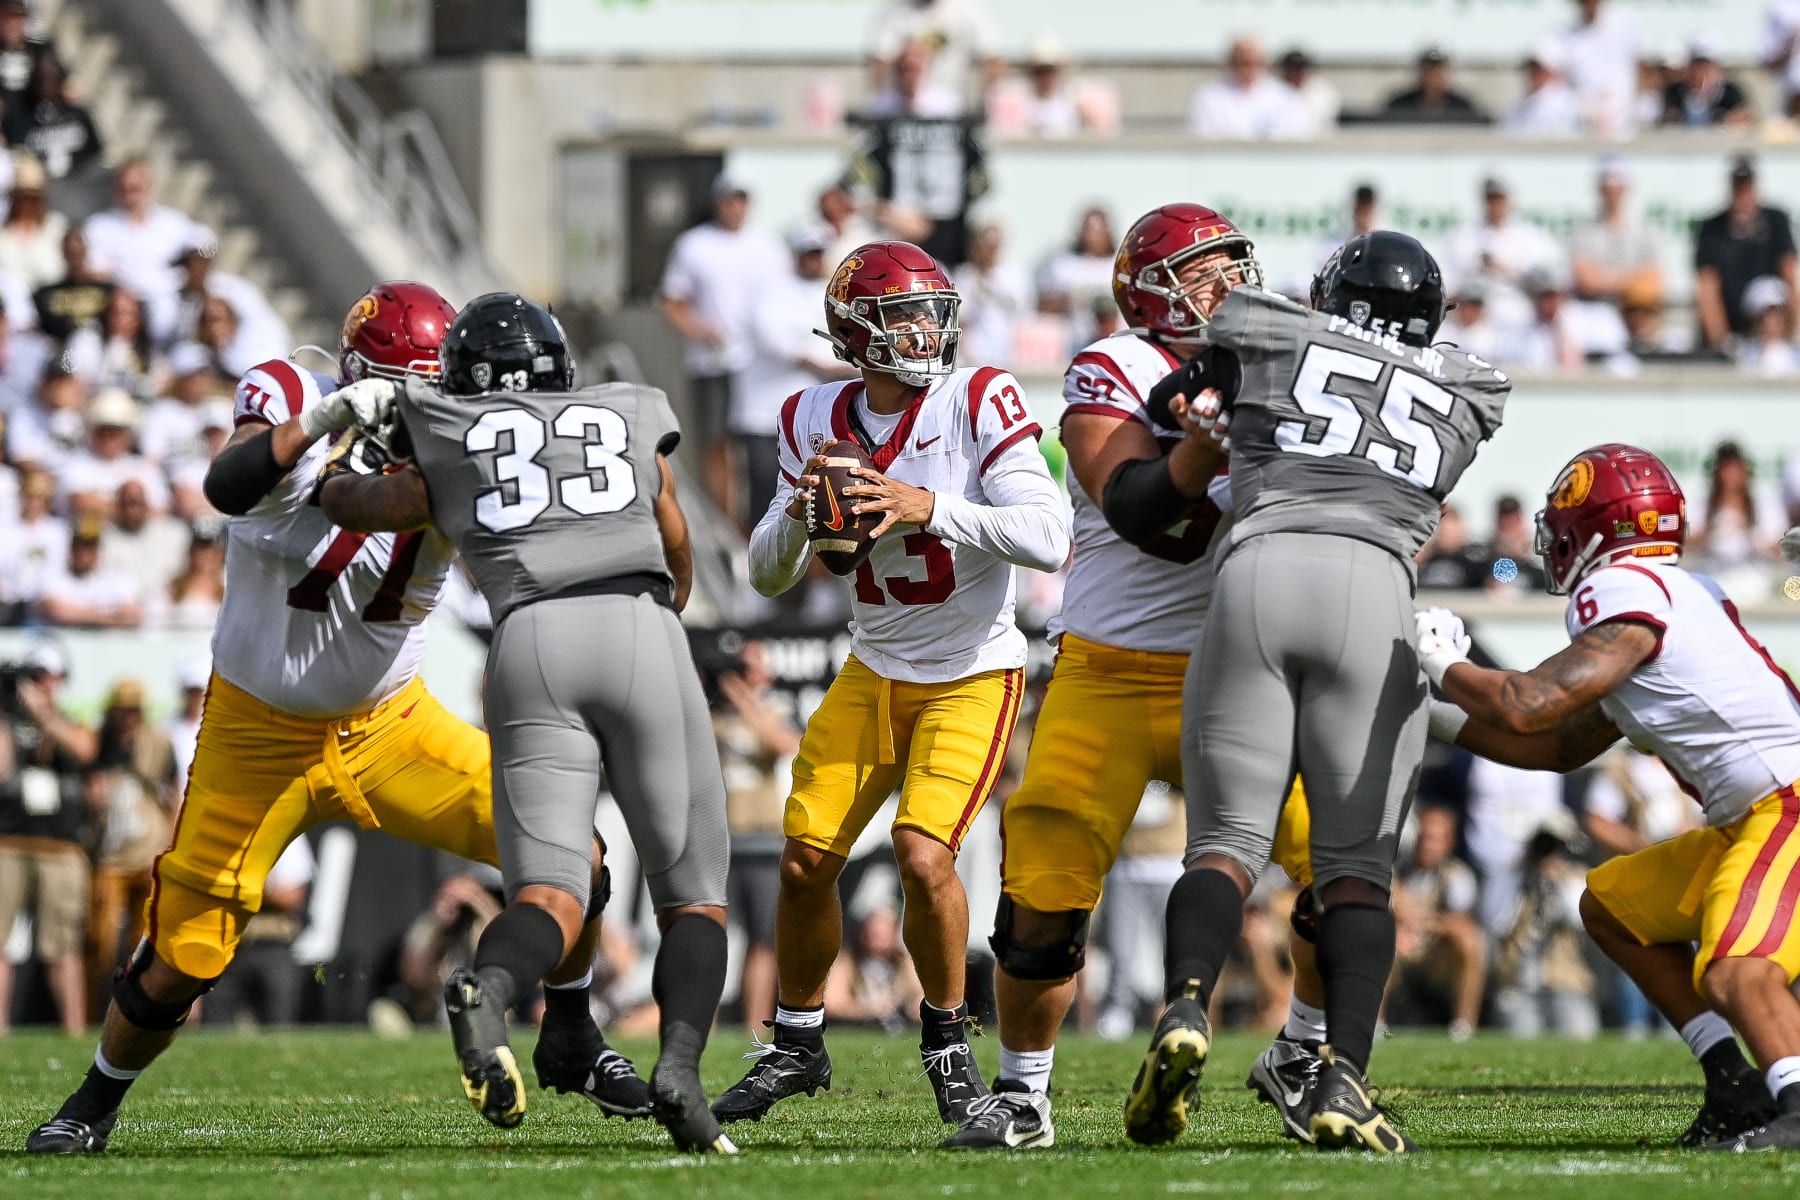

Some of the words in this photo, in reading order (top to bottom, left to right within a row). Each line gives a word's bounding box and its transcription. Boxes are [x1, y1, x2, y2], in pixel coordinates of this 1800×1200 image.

[885, 285, 901, 294] USC
[1371, 317, 1404, 338] 55
[243, 382, 271, 416] 71
[500, 369, 529, 392] 33
[989, 384, 1028, 431] 13
[1273, 342, 1456, 489] 55
[465, 403, 638, 534] 33
[1576, 586, 1599, 626] 6
